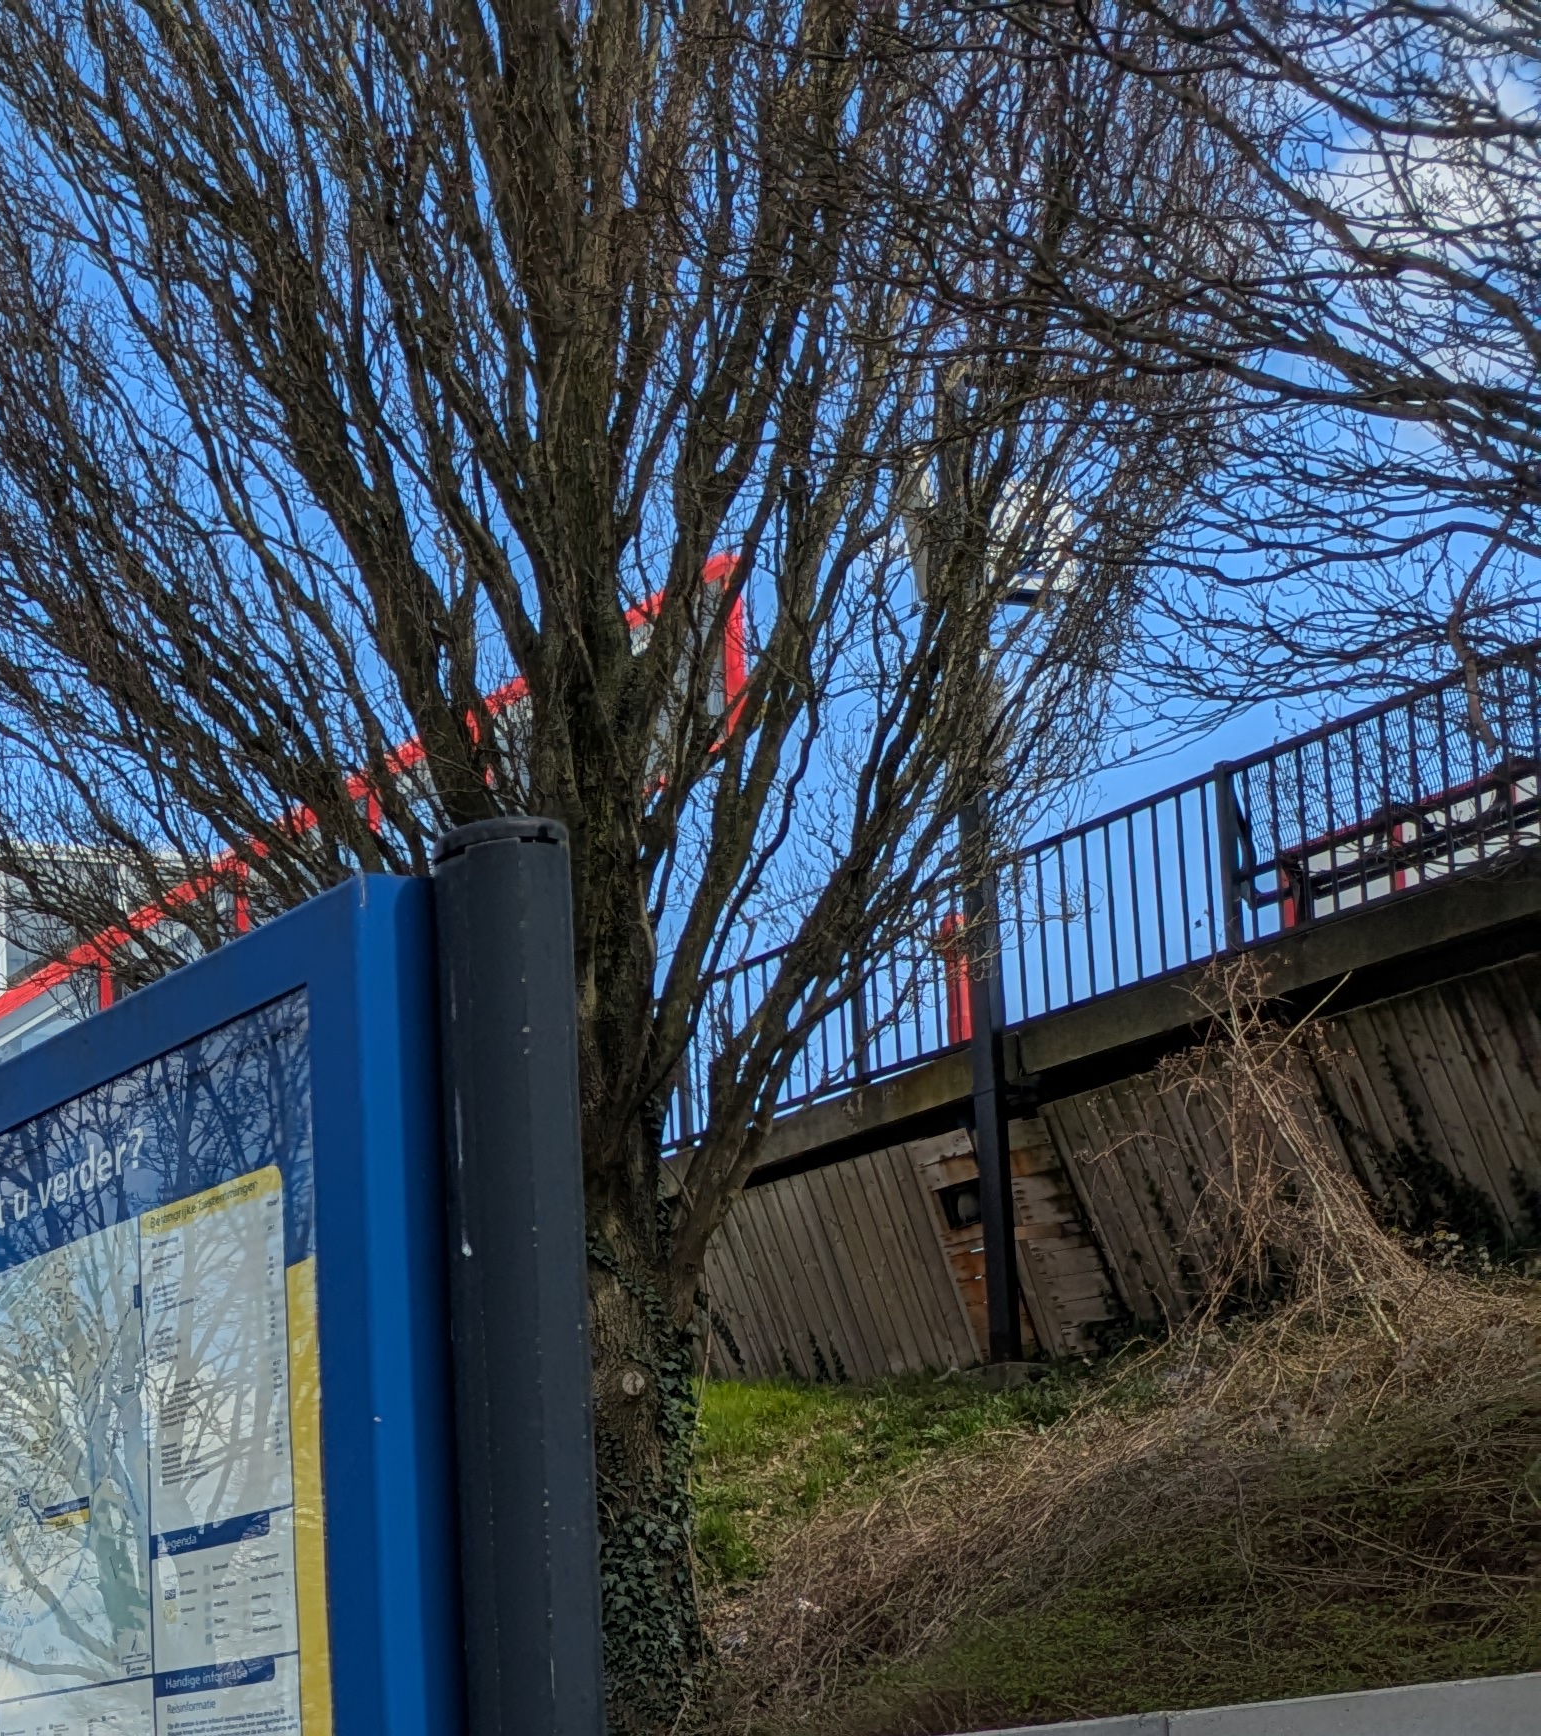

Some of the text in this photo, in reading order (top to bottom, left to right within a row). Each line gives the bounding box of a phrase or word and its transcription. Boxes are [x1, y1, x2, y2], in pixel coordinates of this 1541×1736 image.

[13, 1189, 29, 1221] u
[37, 1127, 145, 1209] verder?
[150, 1205, 197, 1229] Belangrijke
[165, 1676, 201, 1690] Handige
[167, 1700, 216, 1714] Reisinformatie
